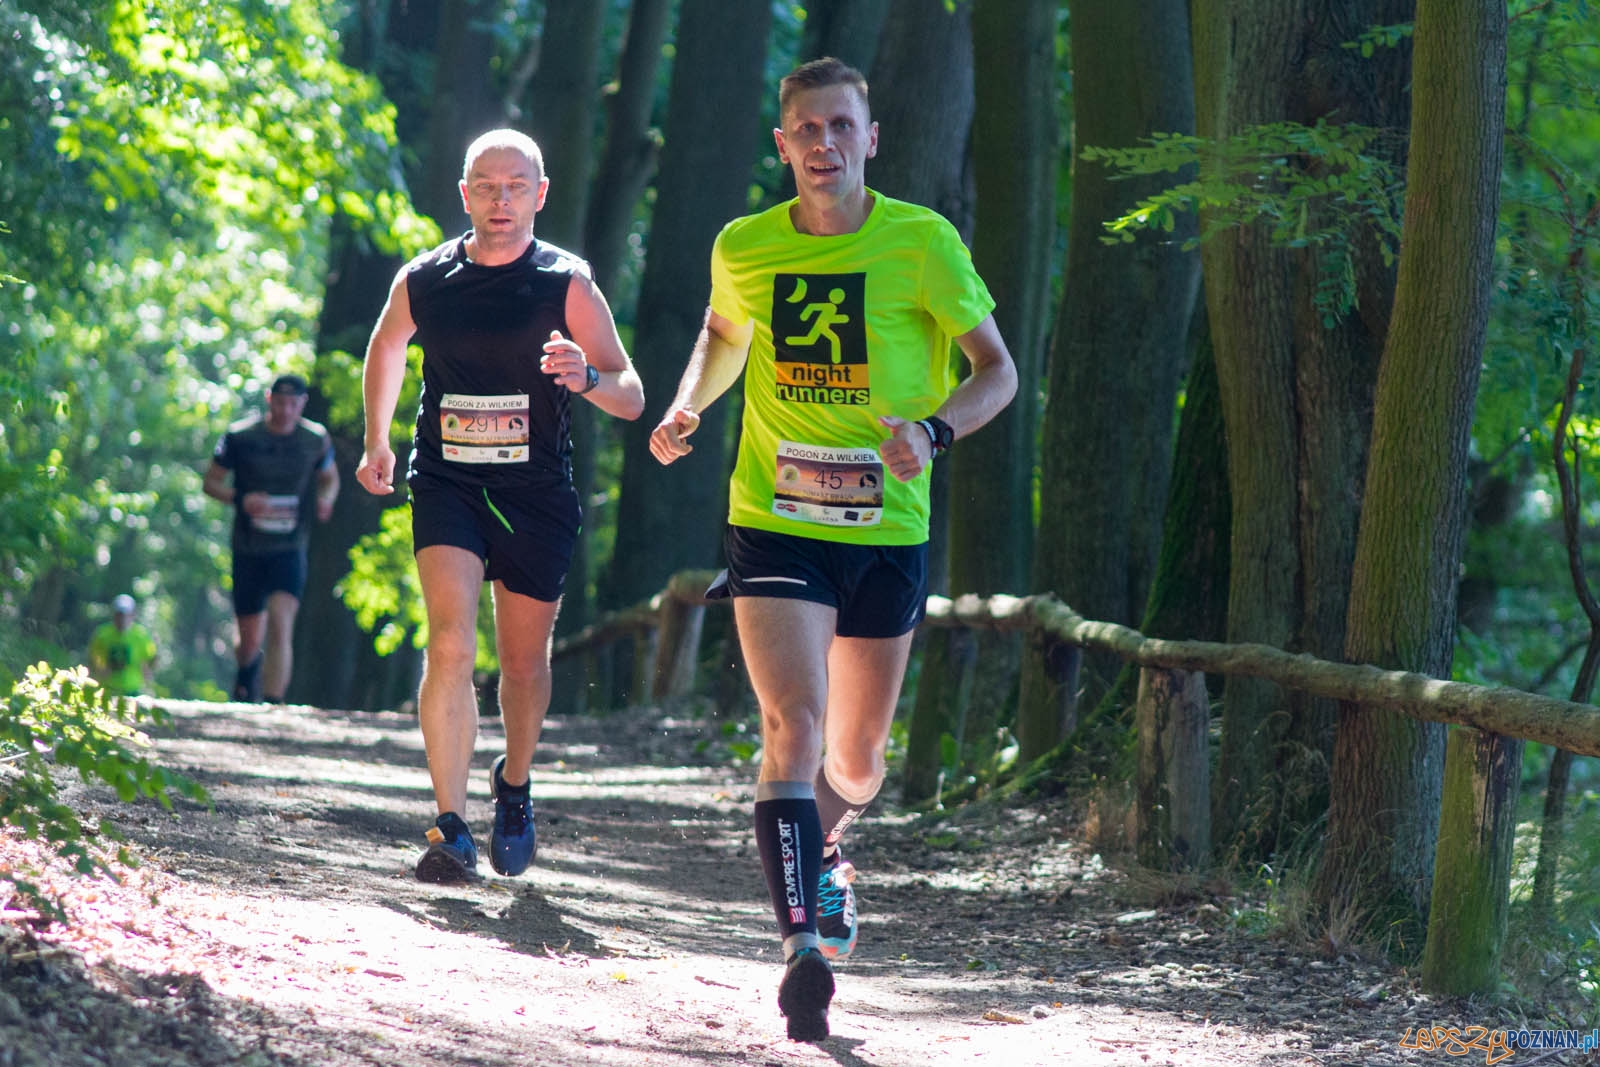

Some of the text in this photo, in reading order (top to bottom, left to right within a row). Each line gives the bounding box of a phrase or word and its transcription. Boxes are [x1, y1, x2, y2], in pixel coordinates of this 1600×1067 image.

[792, 362, 852, 386] night
[776, 384, 869, 404] runners
[475, 400, 487, 408] ZA
[488, 400, 523, 409] WILKIEM
[464, 415, 499, 433] 291
[821, 452, 835, 461] ZA
[836, 453, 876, 462] WILKIEM
[813, 469, 844, 490] 45
